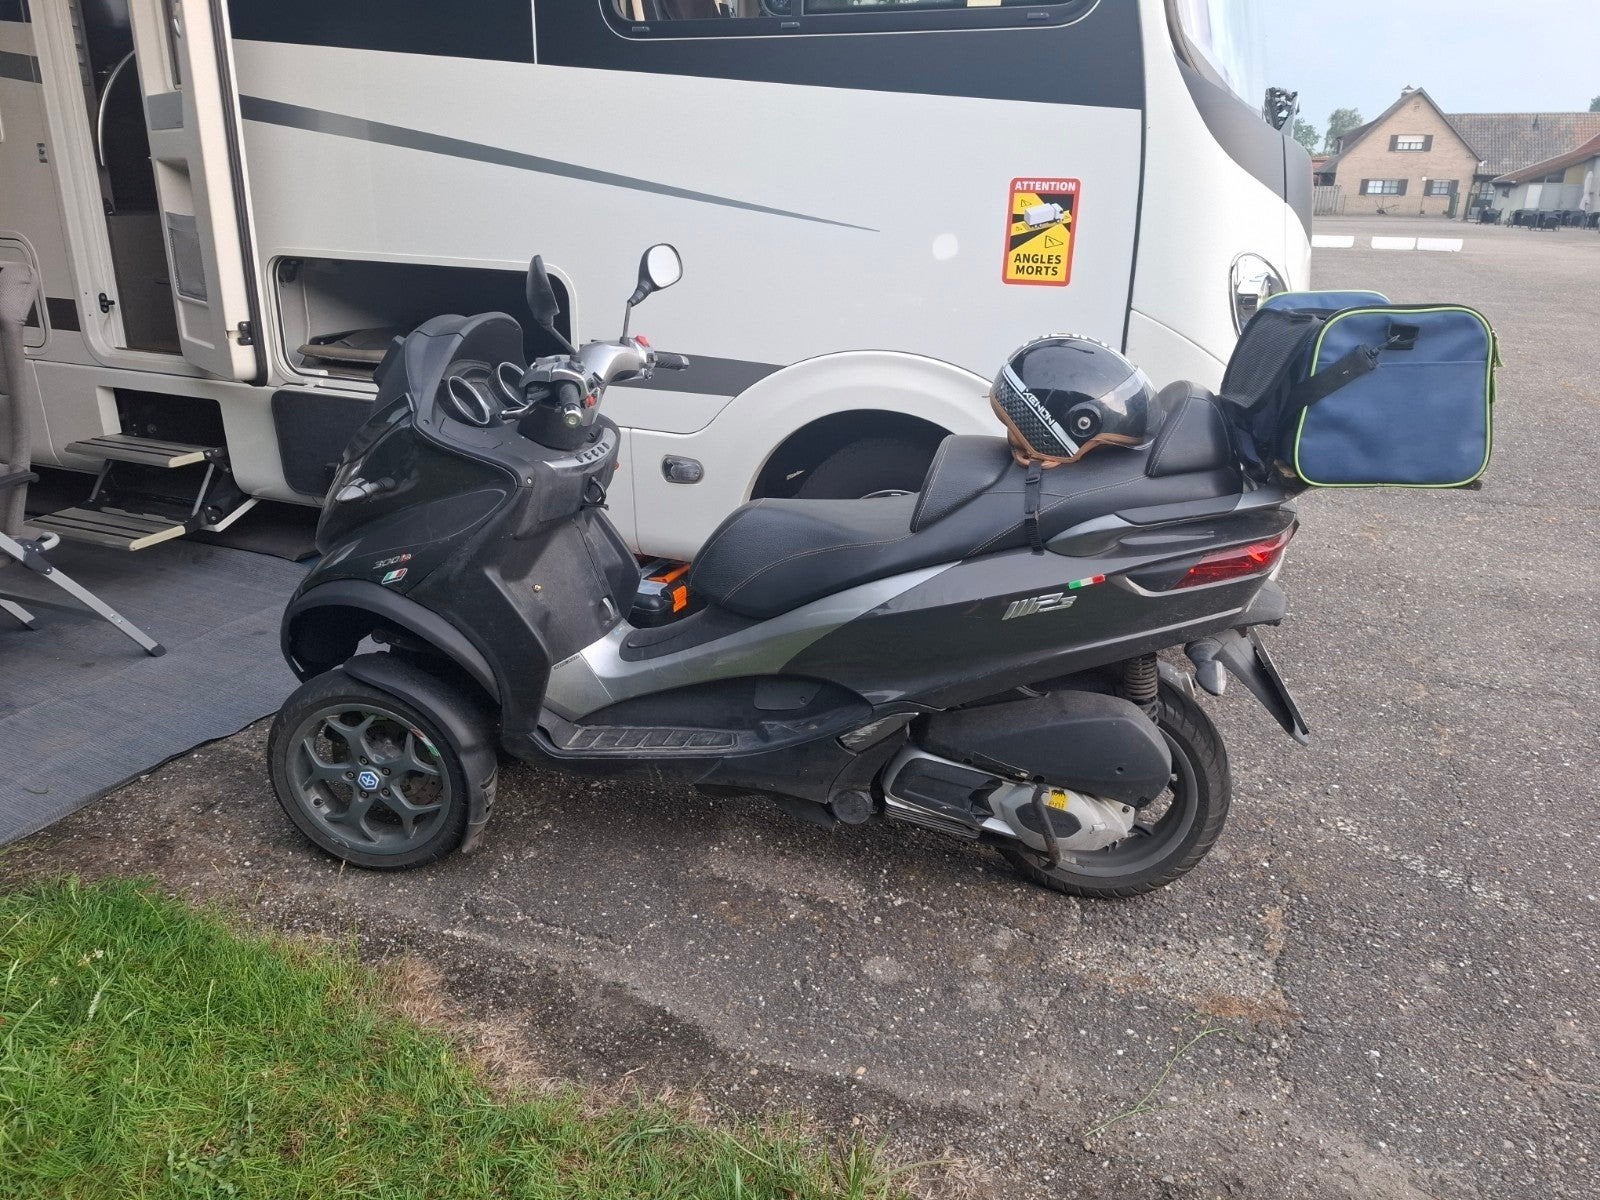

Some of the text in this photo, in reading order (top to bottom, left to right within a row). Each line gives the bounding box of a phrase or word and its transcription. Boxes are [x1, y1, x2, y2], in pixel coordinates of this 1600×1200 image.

[1015, 181, 1076, 191] ATTENTION
[1014, 253, 1062, 265] ANGLES
[1015, 265, 1058, 276] MORTS
[1023, 389, 1055, 426] XENON
